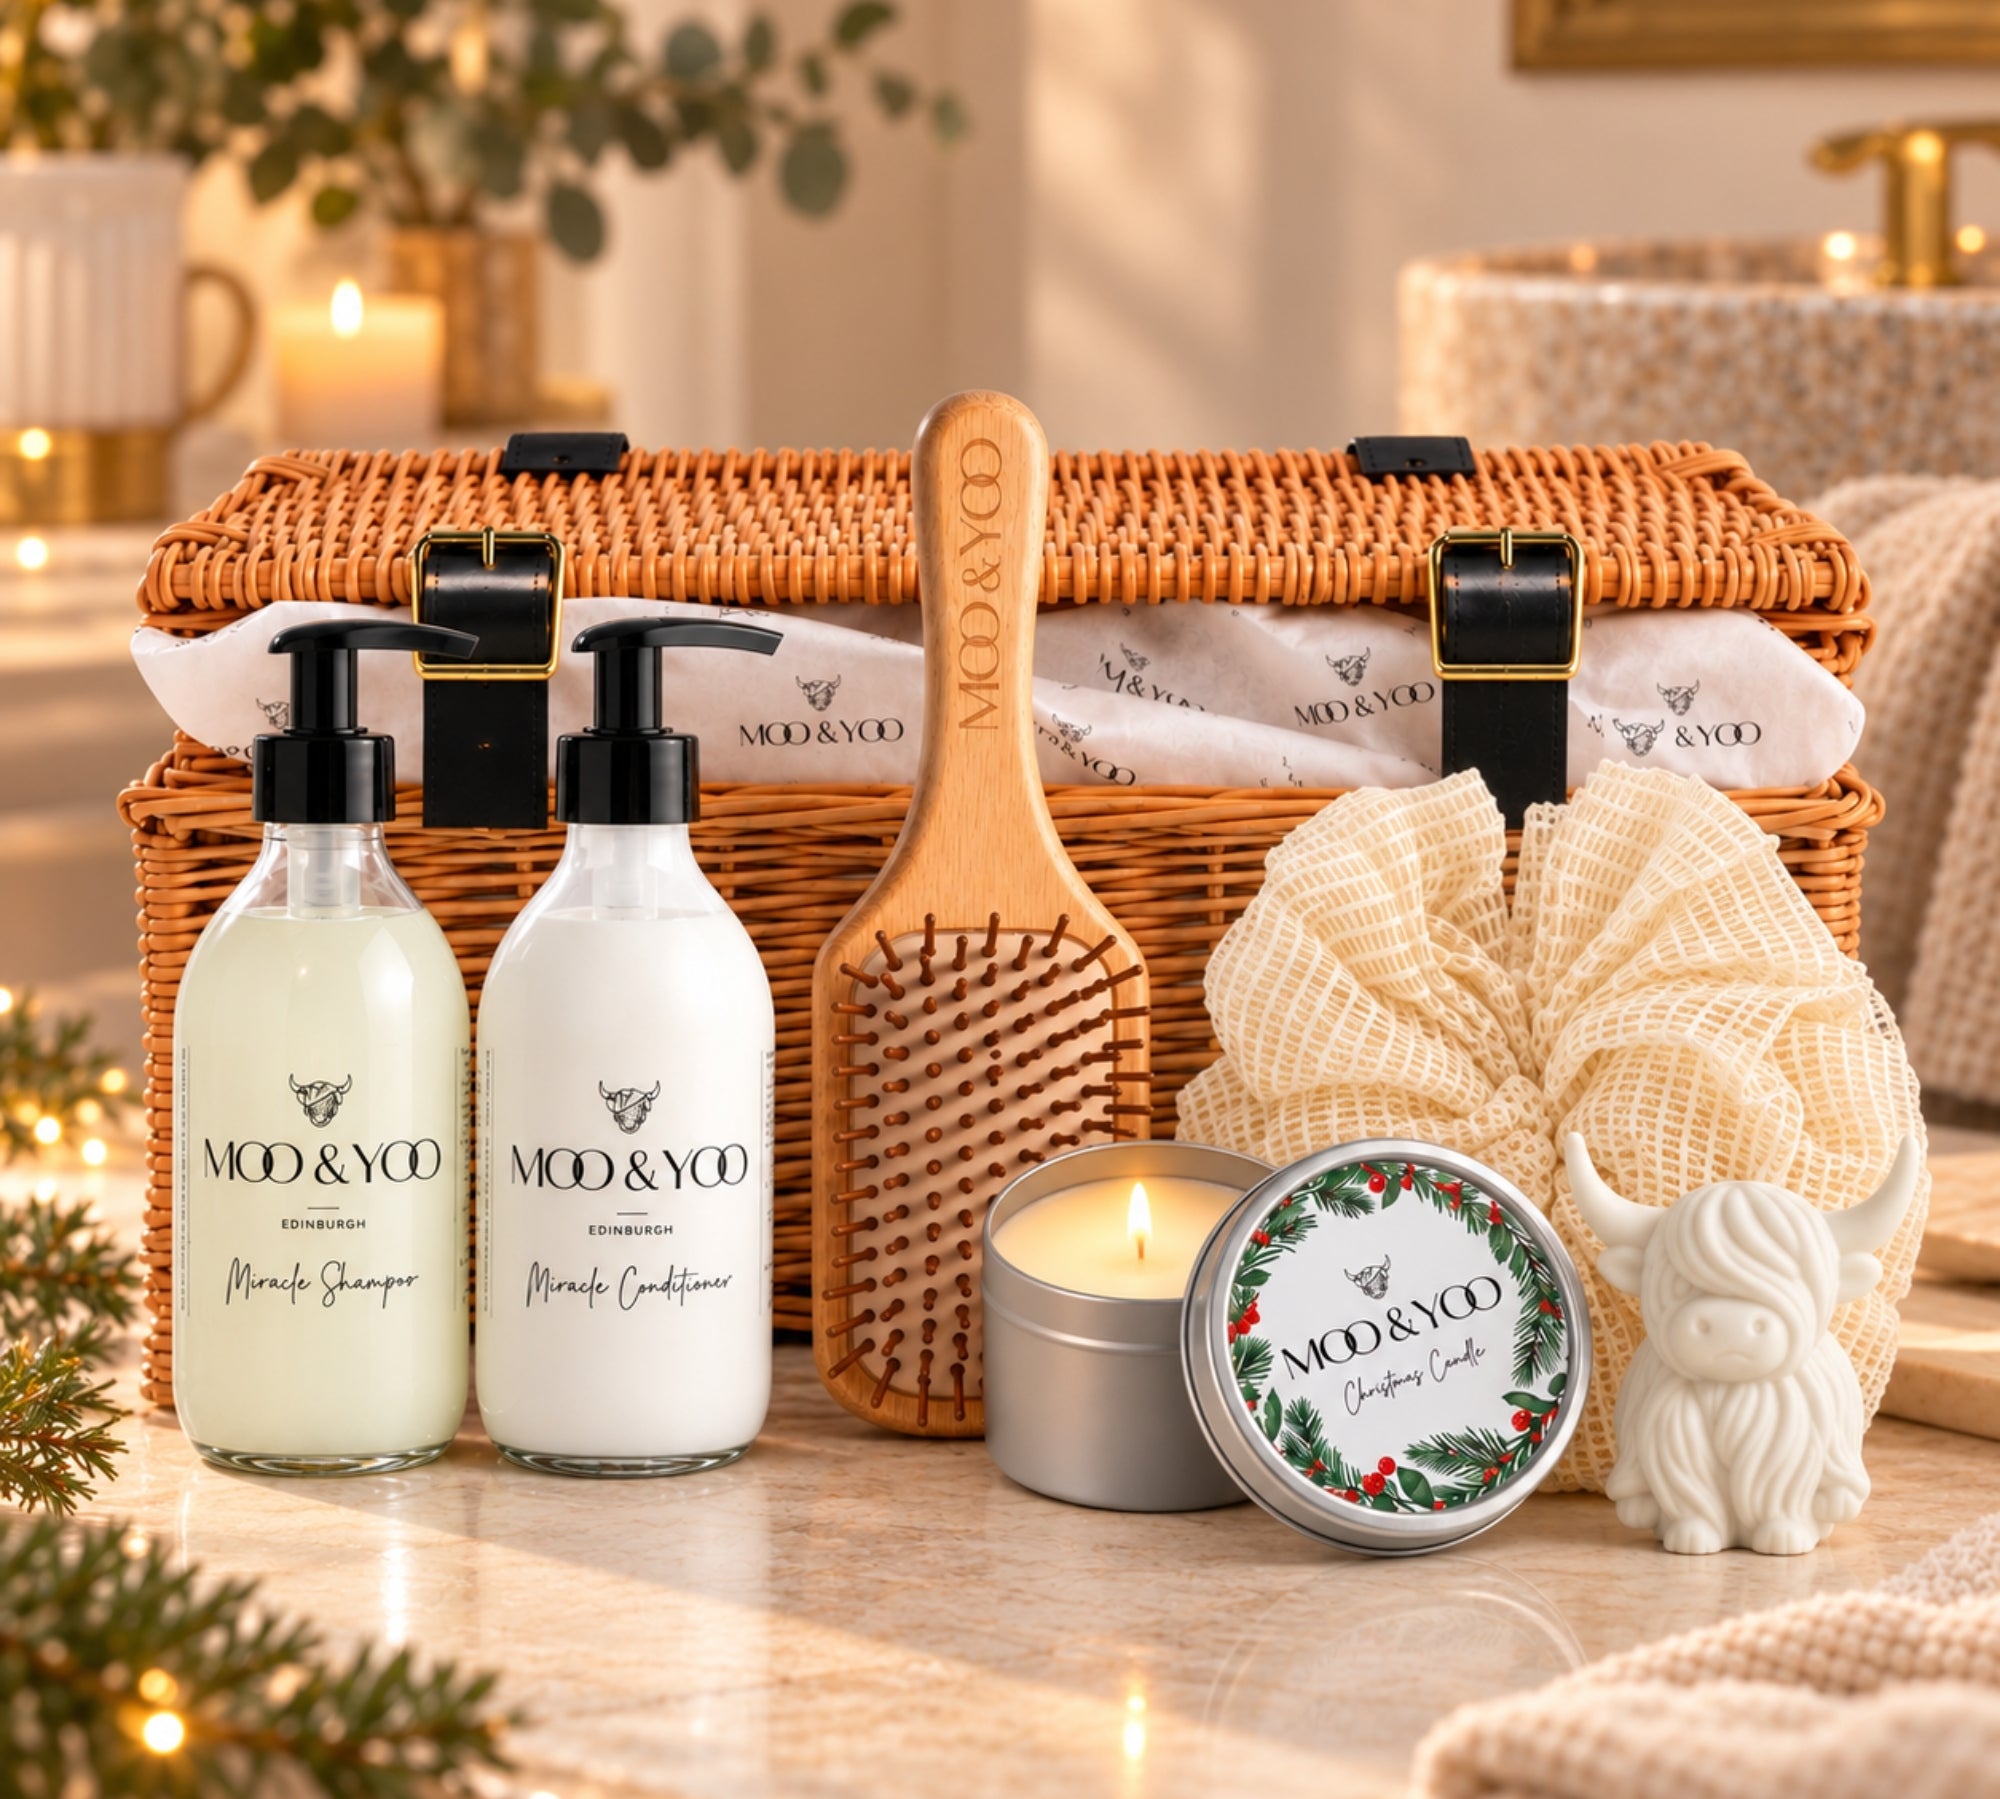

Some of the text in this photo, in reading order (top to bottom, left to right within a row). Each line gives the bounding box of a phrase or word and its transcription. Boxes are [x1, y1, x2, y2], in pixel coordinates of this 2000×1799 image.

[958, 438, 1002, 730] MOO & YOO
[1294, 681, 1435, 727] MOO & YOO
[739, 717, 904, 747] MOO & YOO
[1675, 721, 1762, 748] & YOO
[1081, 751, 1137, 786] YOO
[204, 1138, 441, 1185] MOO & YOO
[511, 1143, 748, 1191] MOO & YOO
[281, 1219, 366, 1230] EDINBURGH
[588, 1225, 673, 1236] EDINBURGH
[226, 1257, 419, 1309] Miracle Shampoo
[526, 1261, 733, 1311] Miracle Conditioner
[1281, 1276, 1501, 1380] MOO & YOO
[1344, 1337, 1486, 1416] Christmas Candle
